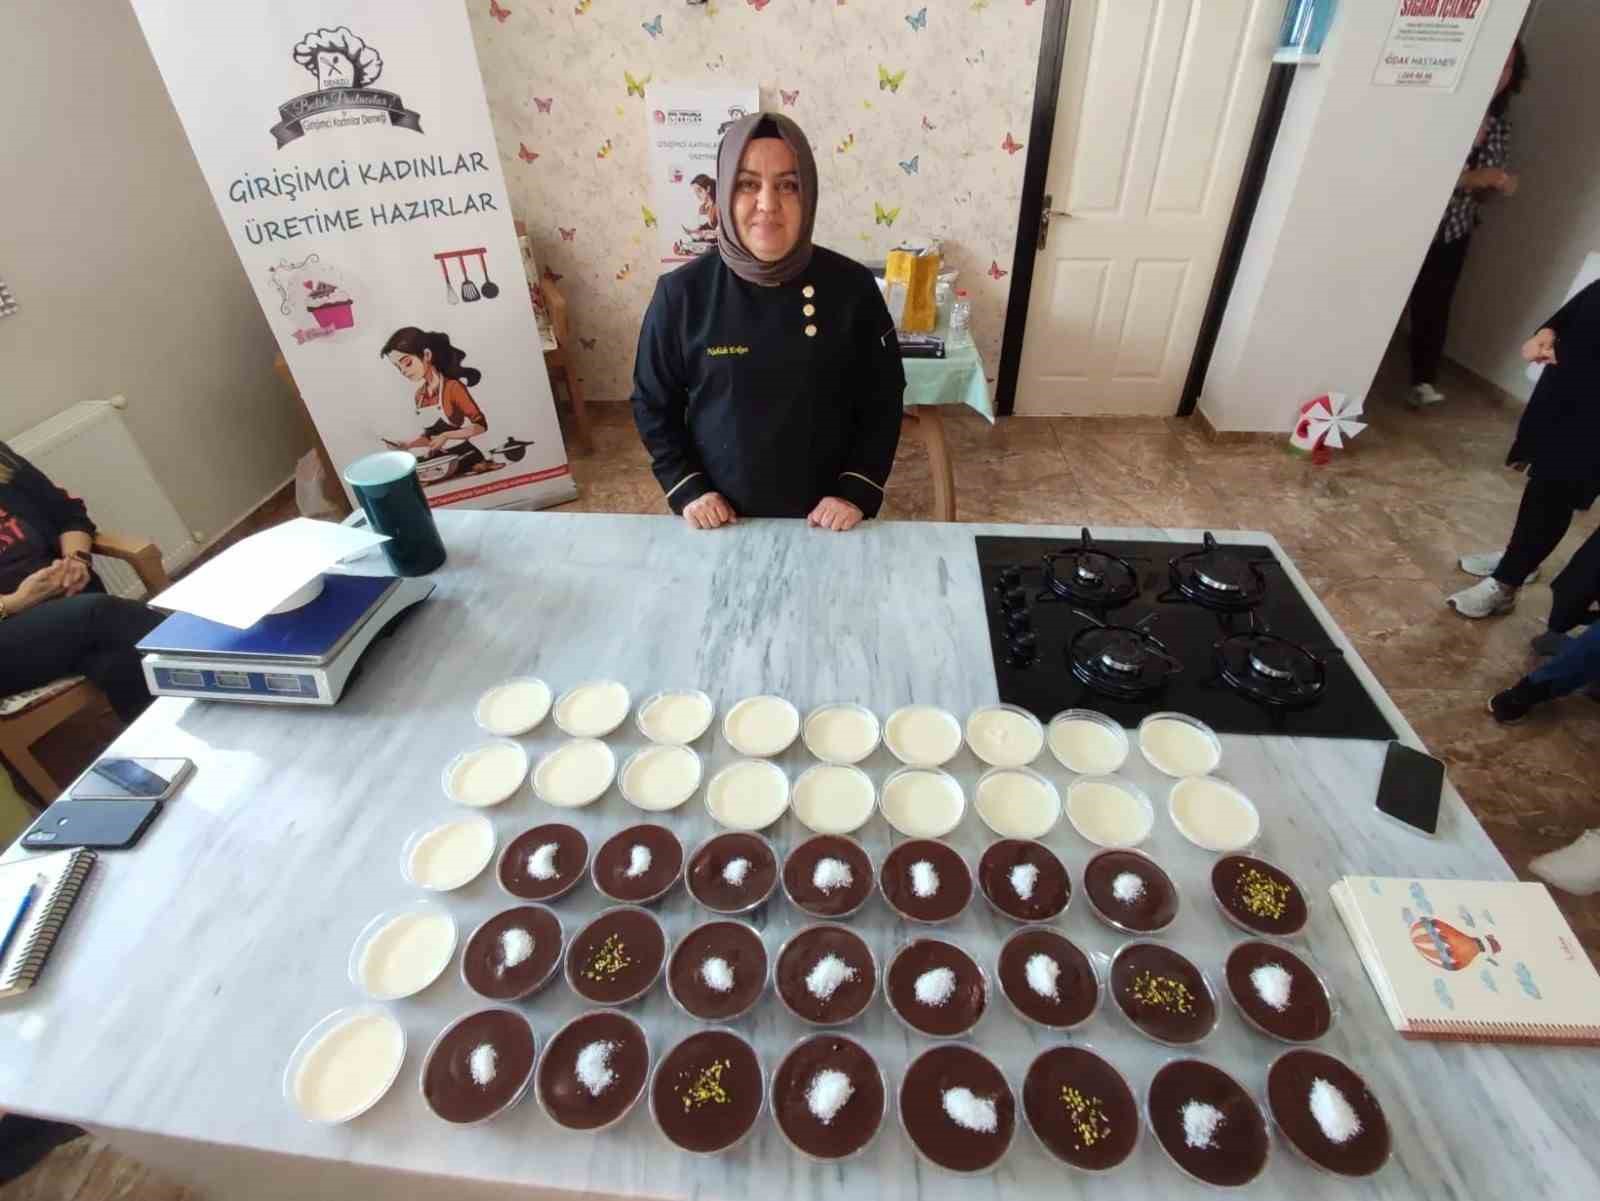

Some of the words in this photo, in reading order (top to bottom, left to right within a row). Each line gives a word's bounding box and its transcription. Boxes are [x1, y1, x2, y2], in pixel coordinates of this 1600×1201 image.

[228, 159, 351, 204] GİRİŞİMCİ
[358, 151, 489, 186] KADINLAR
[244, 207, 363, 245] ÜRETİME
[370, 192, 498, 227] HAZIRLAR
